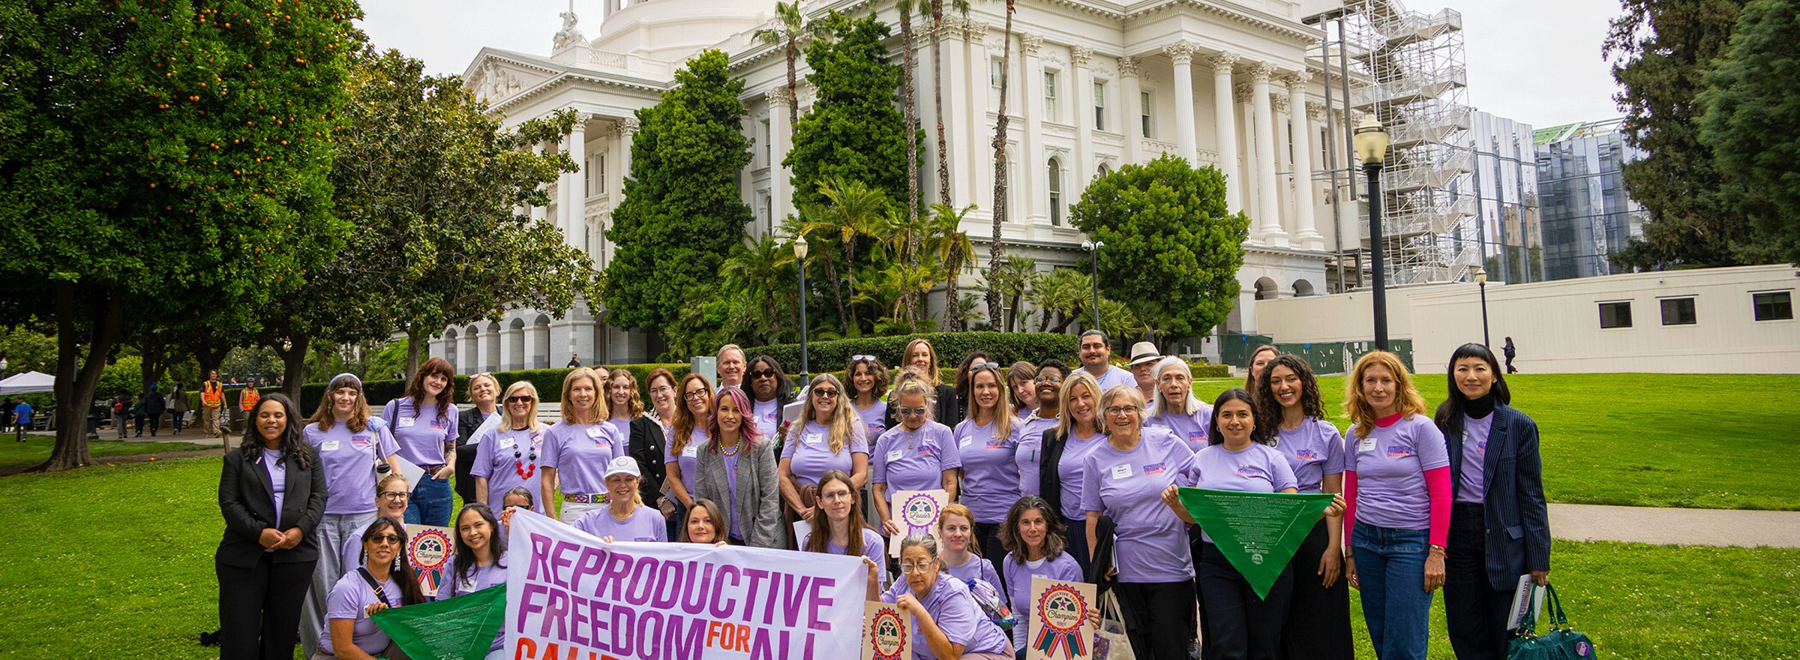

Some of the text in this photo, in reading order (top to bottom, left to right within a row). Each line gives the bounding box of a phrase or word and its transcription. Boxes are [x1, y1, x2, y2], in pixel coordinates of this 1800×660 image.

[526, 532, 837, 631] REPRODUCTIVE
[1047, 610, 1078, 622] Champion
[517, 583, 708, 660] FREEDOM
[706, 621, 751, 653] FOR
